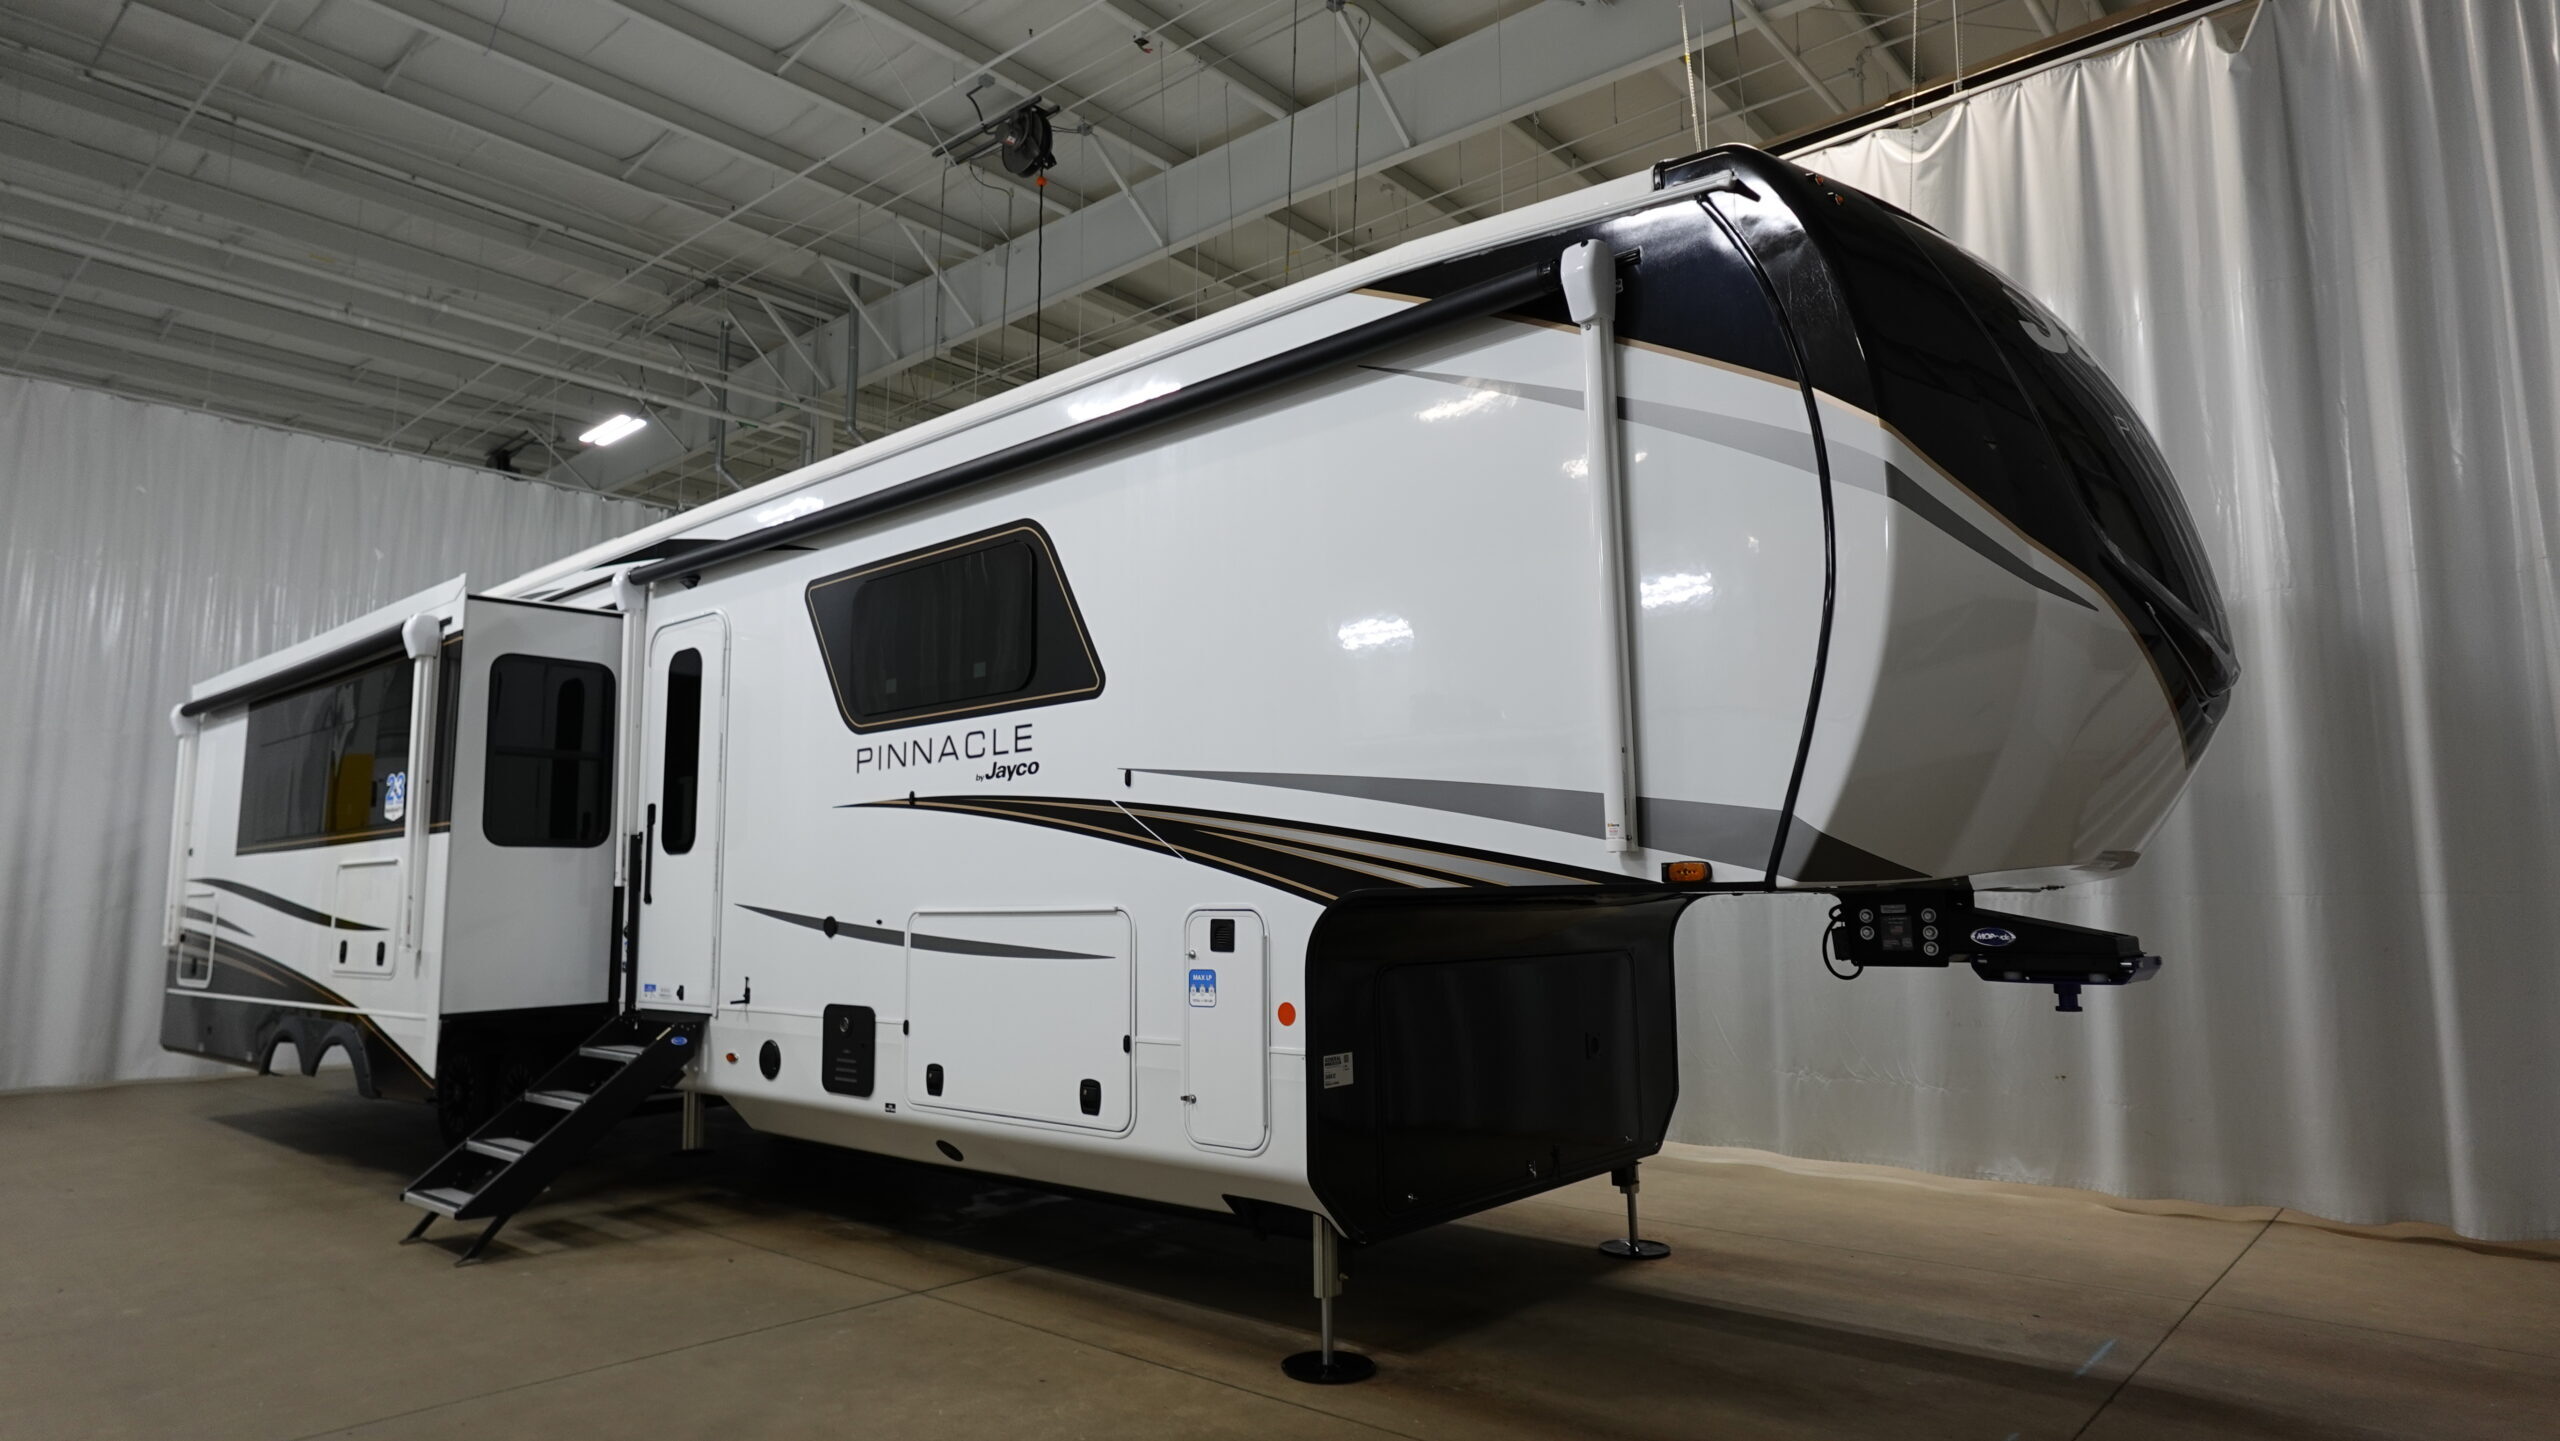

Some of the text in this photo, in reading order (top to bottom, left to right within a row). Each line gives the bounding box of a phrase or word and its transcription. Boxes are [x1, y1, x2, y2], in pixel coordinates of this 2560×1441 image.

[856, 723, 1033, 774] PINNACLE
[975, 760, 1040, 782] by Jayco
